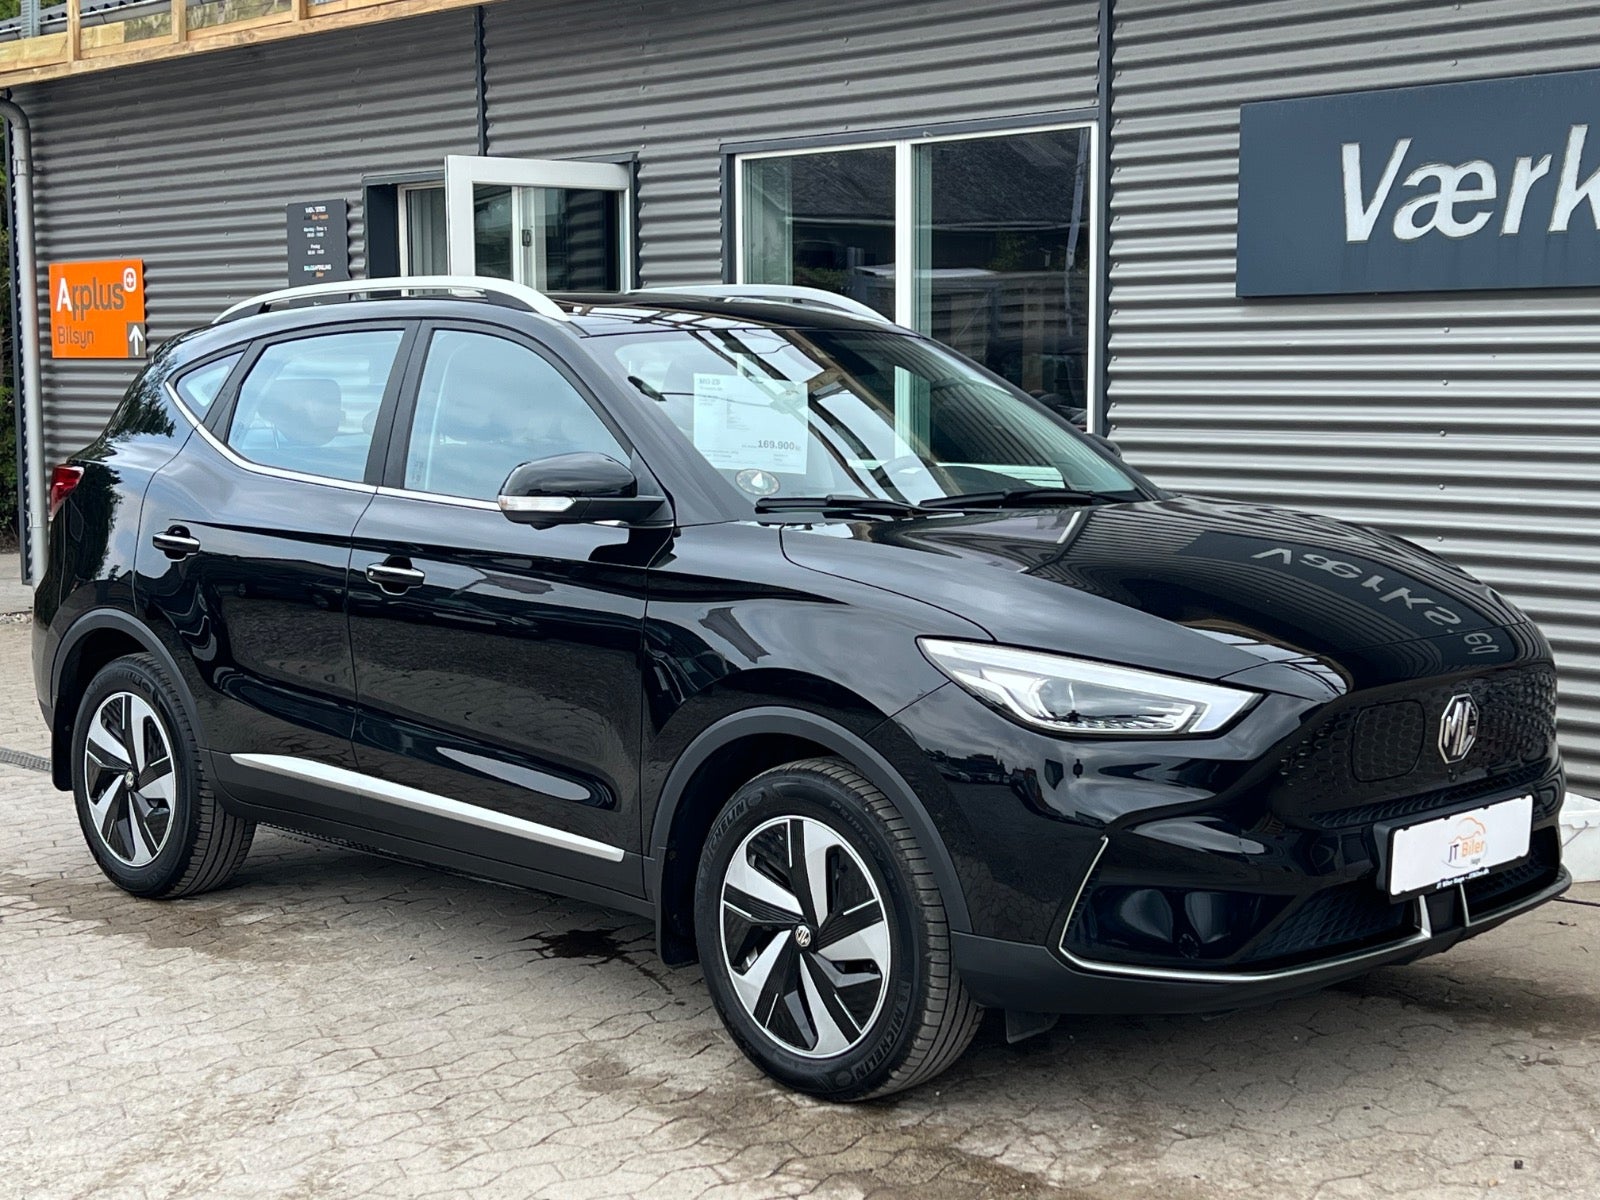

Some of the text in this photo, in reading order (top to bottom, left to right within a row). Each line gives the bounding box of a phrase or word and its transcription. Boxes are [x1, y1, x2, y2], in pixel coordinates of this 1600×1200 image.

[57, 325, 94, 349] Bilsyn
[757, 439, 795, 451] 169.900
[1442, 697, 1479, 760] MG
[1448, 844, 1460, 864] JT
[1461, 839, 1485, 858] Biler
[852, 1004, 906, 1080] MICHELIN
